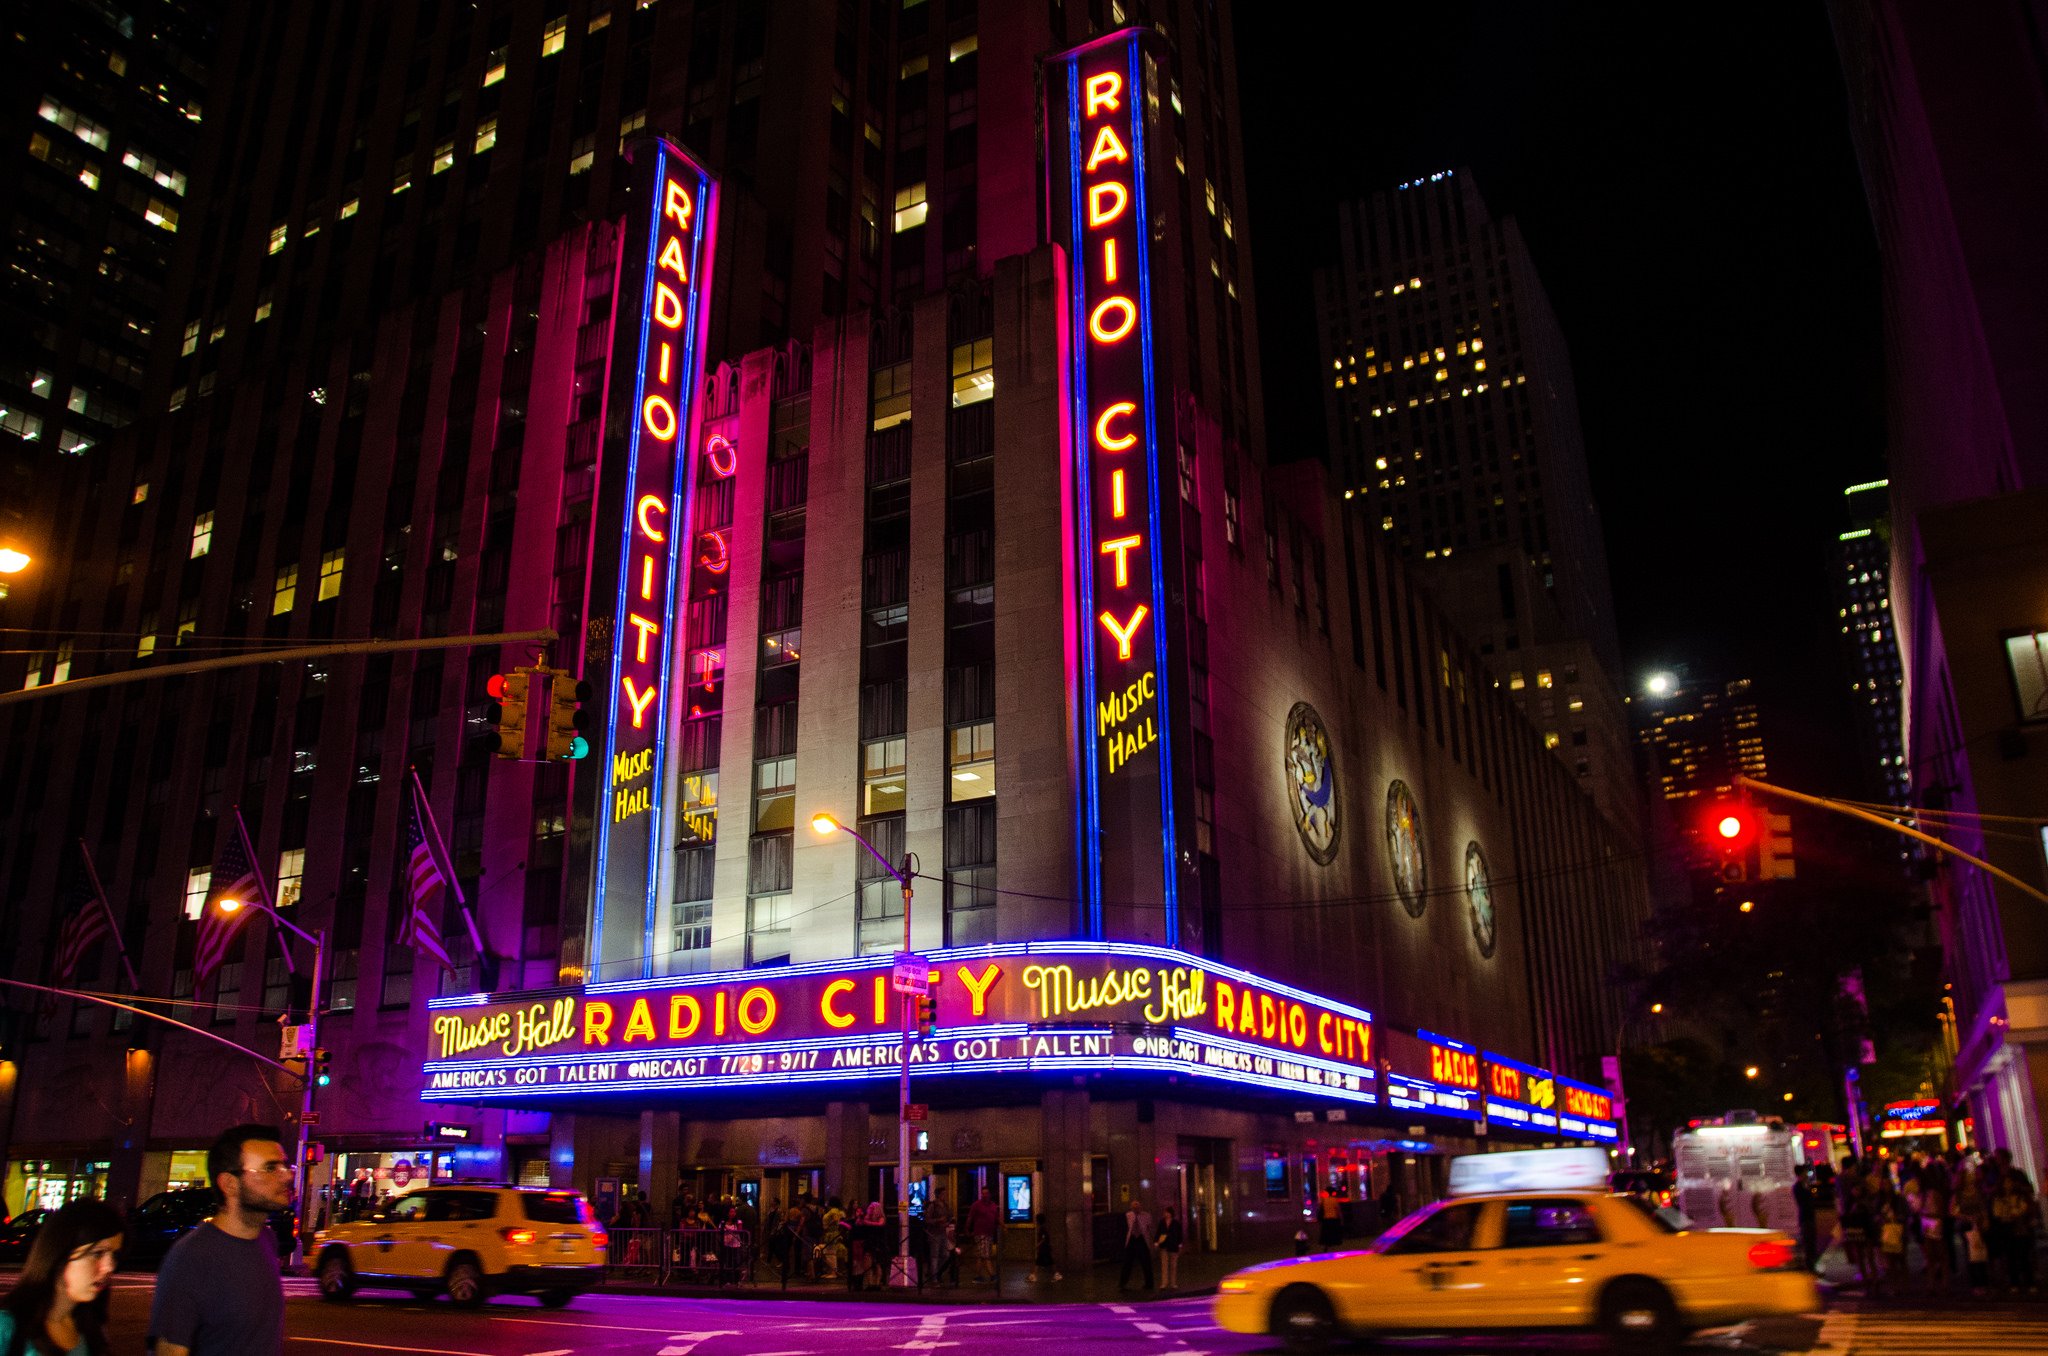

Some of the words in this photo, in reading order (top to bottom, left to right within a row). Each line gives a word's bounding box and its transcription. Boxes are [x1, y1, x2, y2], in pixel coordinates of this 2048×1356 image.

[1086, 71, 1137, 344] RADIO
[643, 178, 692, 442] RADIO
[1095, 402, 1149, 661] CITY
[622, 494, 668, 729] CITY
[1100, 671, 1155, 736] MUSIC
[612, 748, 652, 786] MUSIC
[1108, 717, 1158, 774] HALL
[615, 786, 652, 824] HALL
[583, 987, 776, 1045] RADIO
[821, 963, 1001, 1028] CIY
[1022, 965, 1151, 1018] Music
[1144, 967, 1207, 1023] Hall
[1216, 981, 1307, 1047] RADIO
[1319, 1012, 1371, 1062] CITY
[434, 1012, 511, 1058] Music
[502, 996, 576, 1057] Hall
[431, 1069, 507, 1089] AMERICA'S
[515, 1067, 548, 1085] GOT
[558, 1063, 619, 1082] TALENT
[628, 1057, 708, 1078] @NBCAGT
[720, 1055, 762, 1074] 7/29
[780, 1050, 819, 1070] 9/17
[954, 1037, 1000, 1060] GOT
[1020, 1035, 1113, 1056] TALENT
